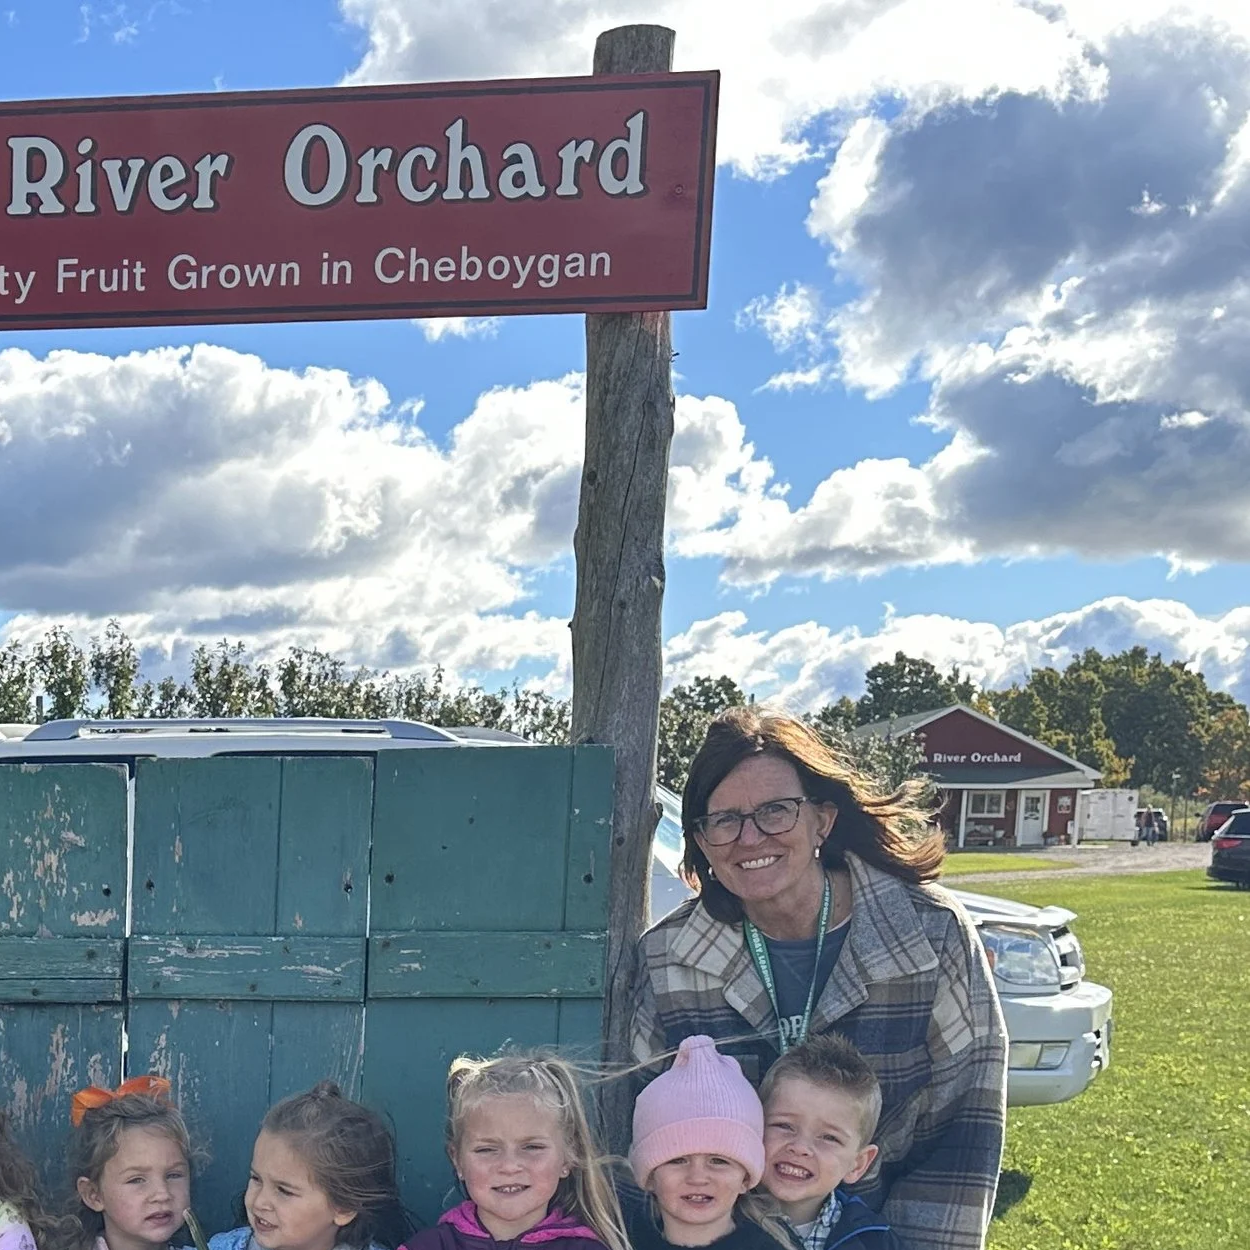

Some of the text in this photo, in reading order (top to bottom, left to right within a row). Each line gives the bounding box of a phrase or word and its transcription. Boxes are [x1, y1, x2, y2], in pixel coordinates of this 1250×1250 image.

[5, 135, 230, 216] River
[283, 110, 645, 207] Orchard
[56, 257, 147, 294] Fruit
[166, 253, 301, 291] Grown
[320, 252, 353, 286] in
[373, 244, 612, 290] Cheboygan
[933, 752, 967, 763] River
[970, 752, 1022, 763] Orchard
